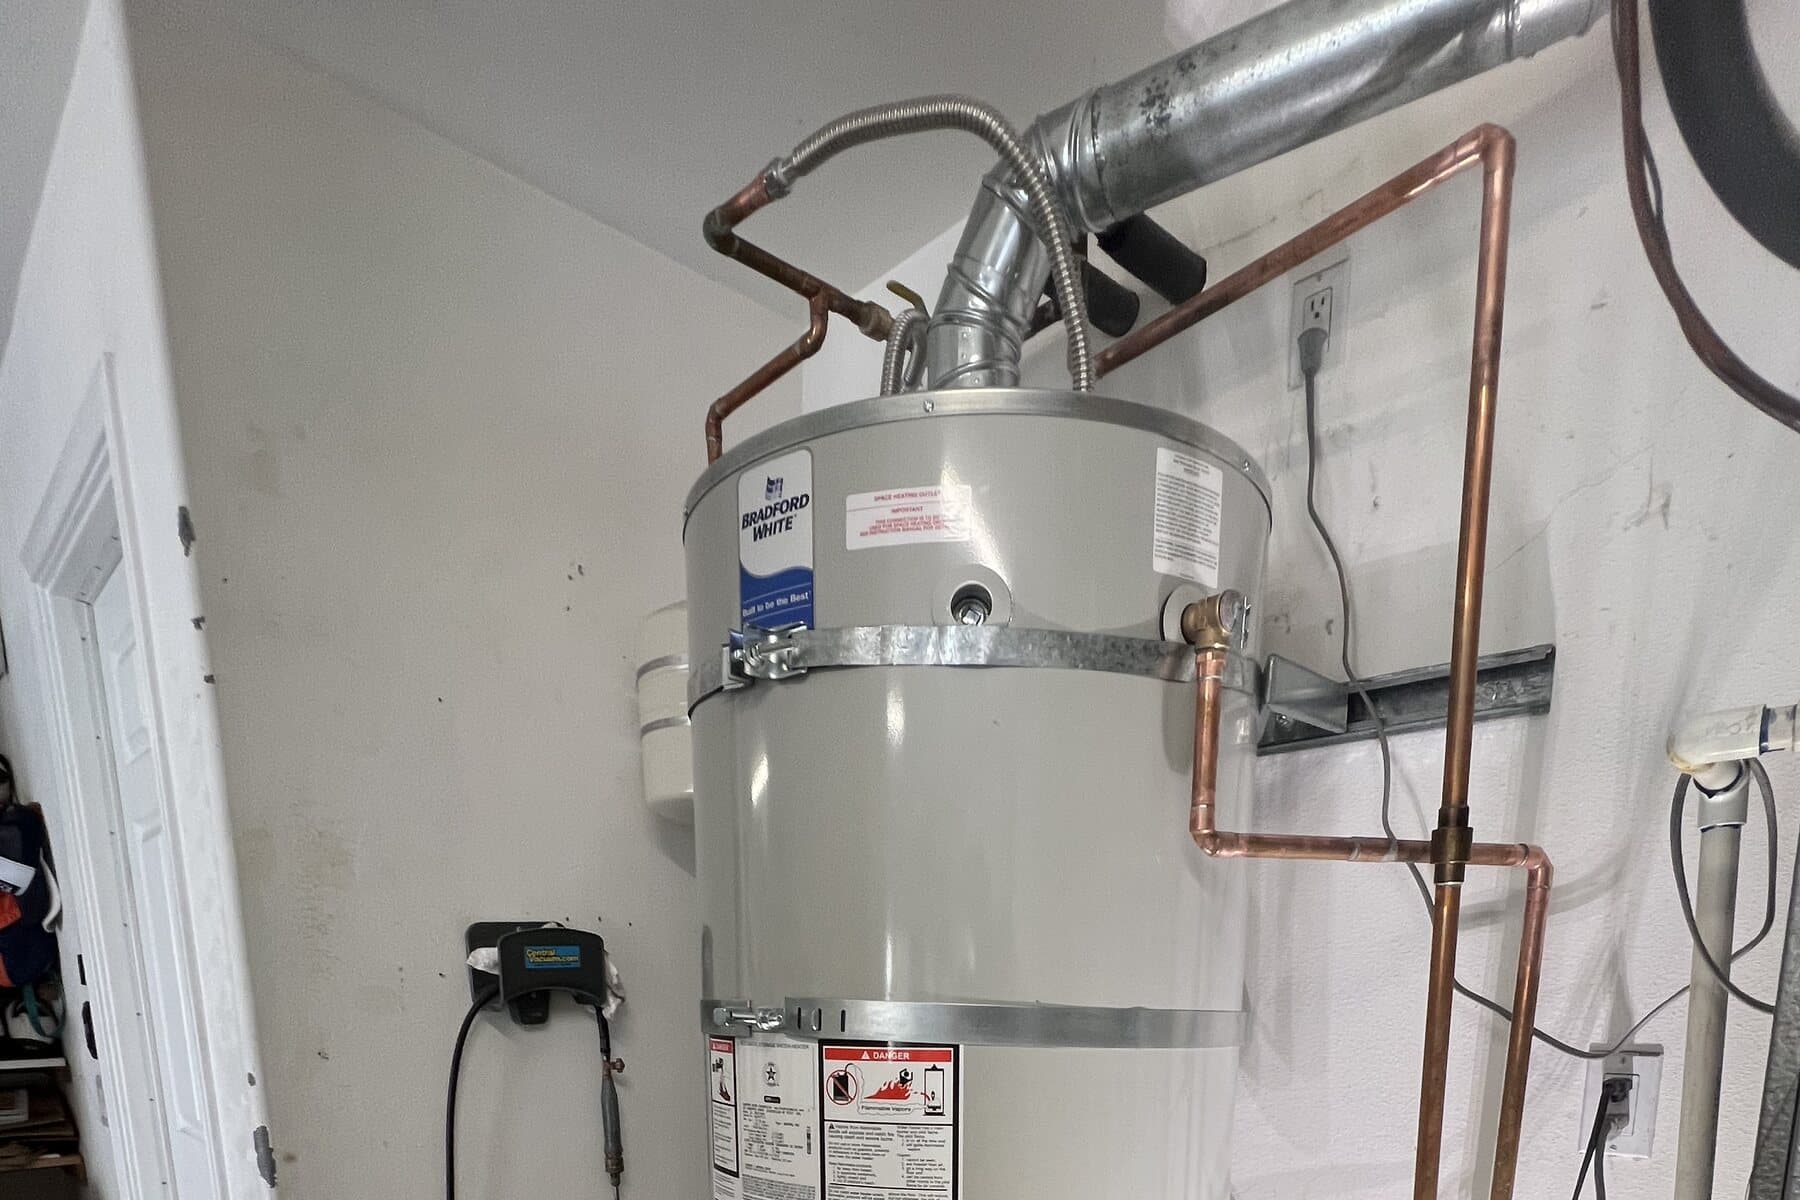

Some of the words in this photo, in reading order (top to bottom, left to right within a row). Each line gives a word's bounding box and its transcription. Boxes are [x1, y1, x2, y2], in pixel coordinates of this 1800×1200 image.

[741, 493, 810, 530] BRADFORD
[752, 515, 794, 542] WHITE
[765, 601, 775, 609] be
[776, 597, 789, 606] the
[790, 591, 809, 603] Best
[873, 1051, 910, 1060] DANGER
